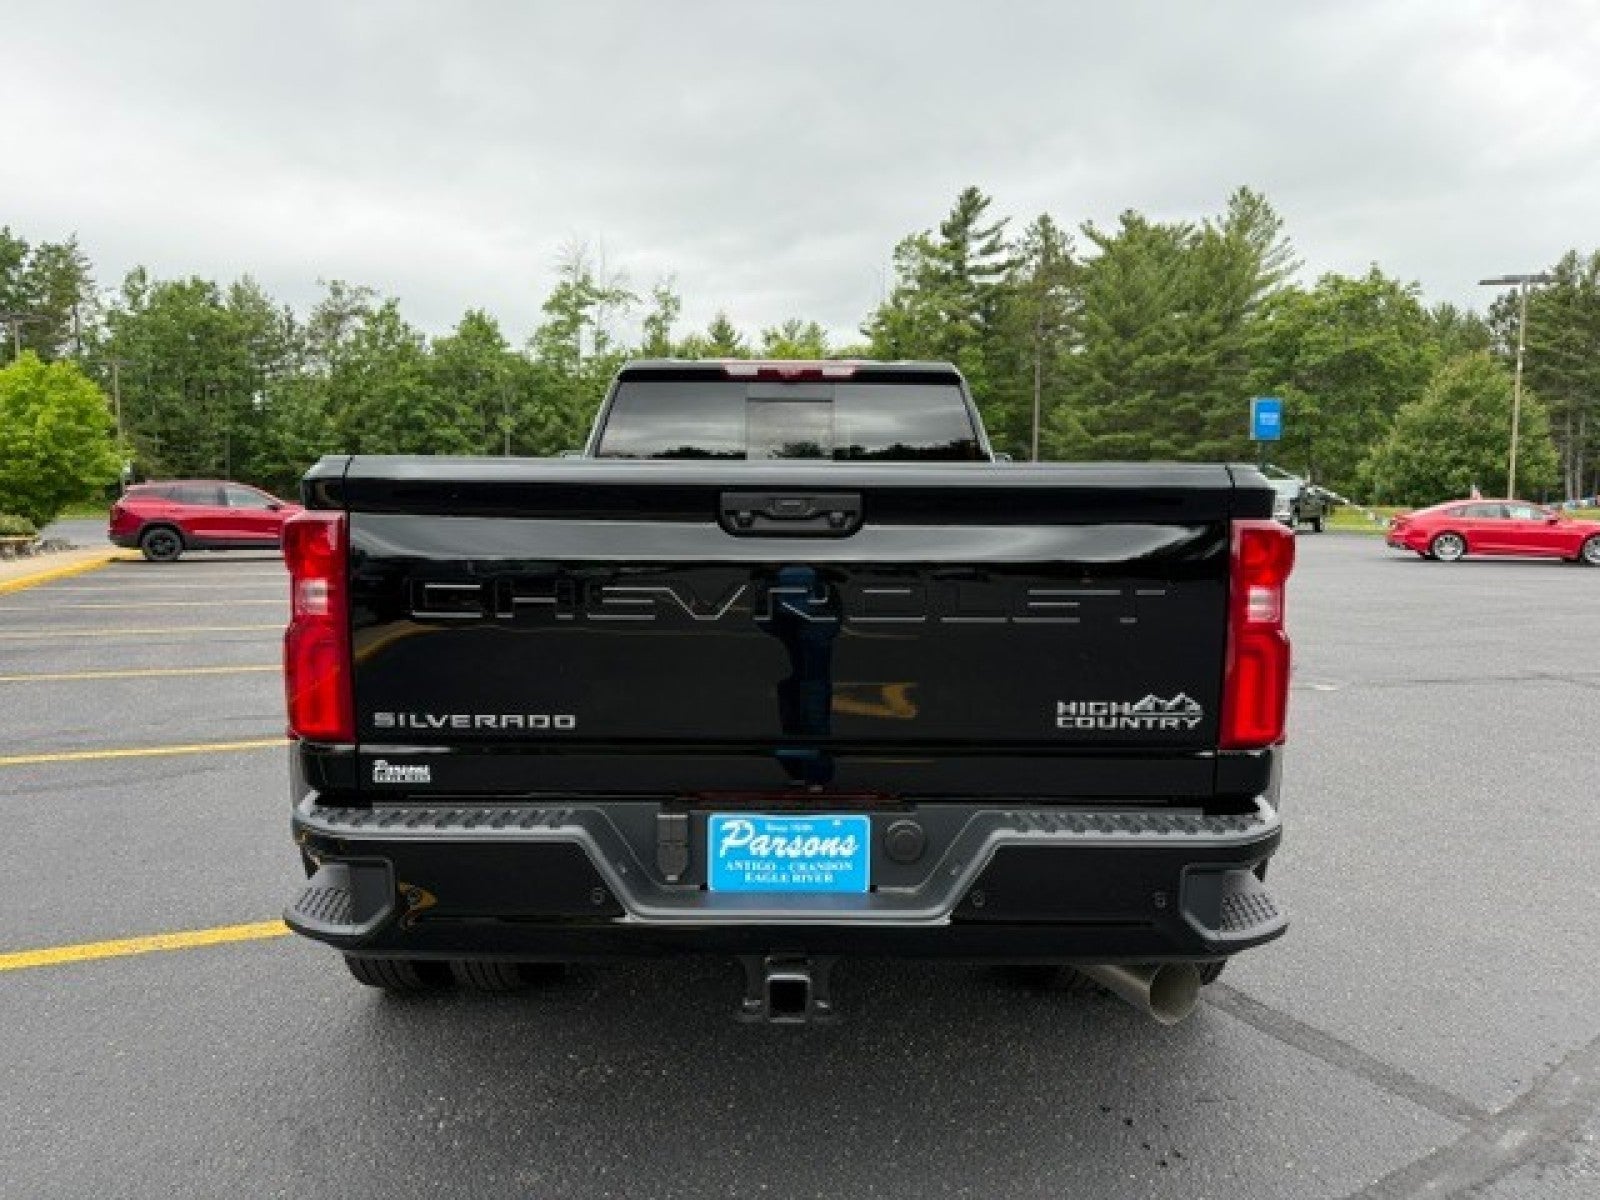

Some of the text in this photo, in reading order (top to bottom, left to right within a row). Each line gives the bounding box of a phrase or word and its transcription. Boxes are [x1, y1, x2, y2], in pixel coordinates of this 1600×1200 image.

[409, 579, 1167, 622] CHEVROLET
[1057, 702, 1130, 715] HIGH
[374, 712, 576, 729] SILVERADO
[1057, 717, 1203, 730] COUNTRY
[719, 819, 860, 858] Parsons
